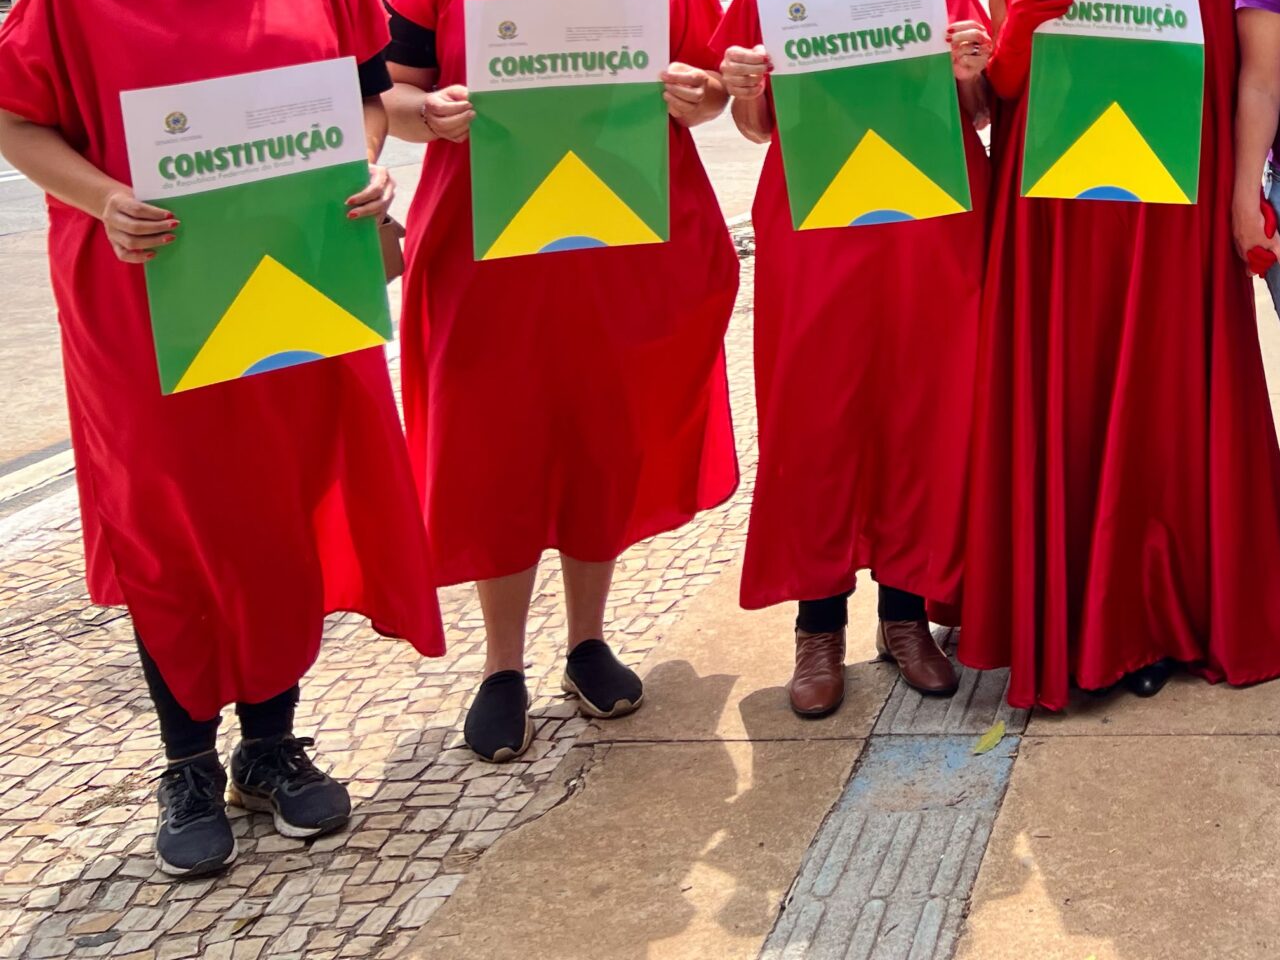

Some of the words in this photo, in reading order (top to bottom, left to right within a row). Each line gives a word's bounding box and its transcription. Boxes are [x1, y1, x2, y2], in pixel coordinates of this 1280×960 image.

[784, 19, 931, 60] CONSTITUIÇÃO
[489, 46, 648, 76] CONSTITUIÇÃO
[158, 123, 344, 181] CONSTITUIÇÃO
